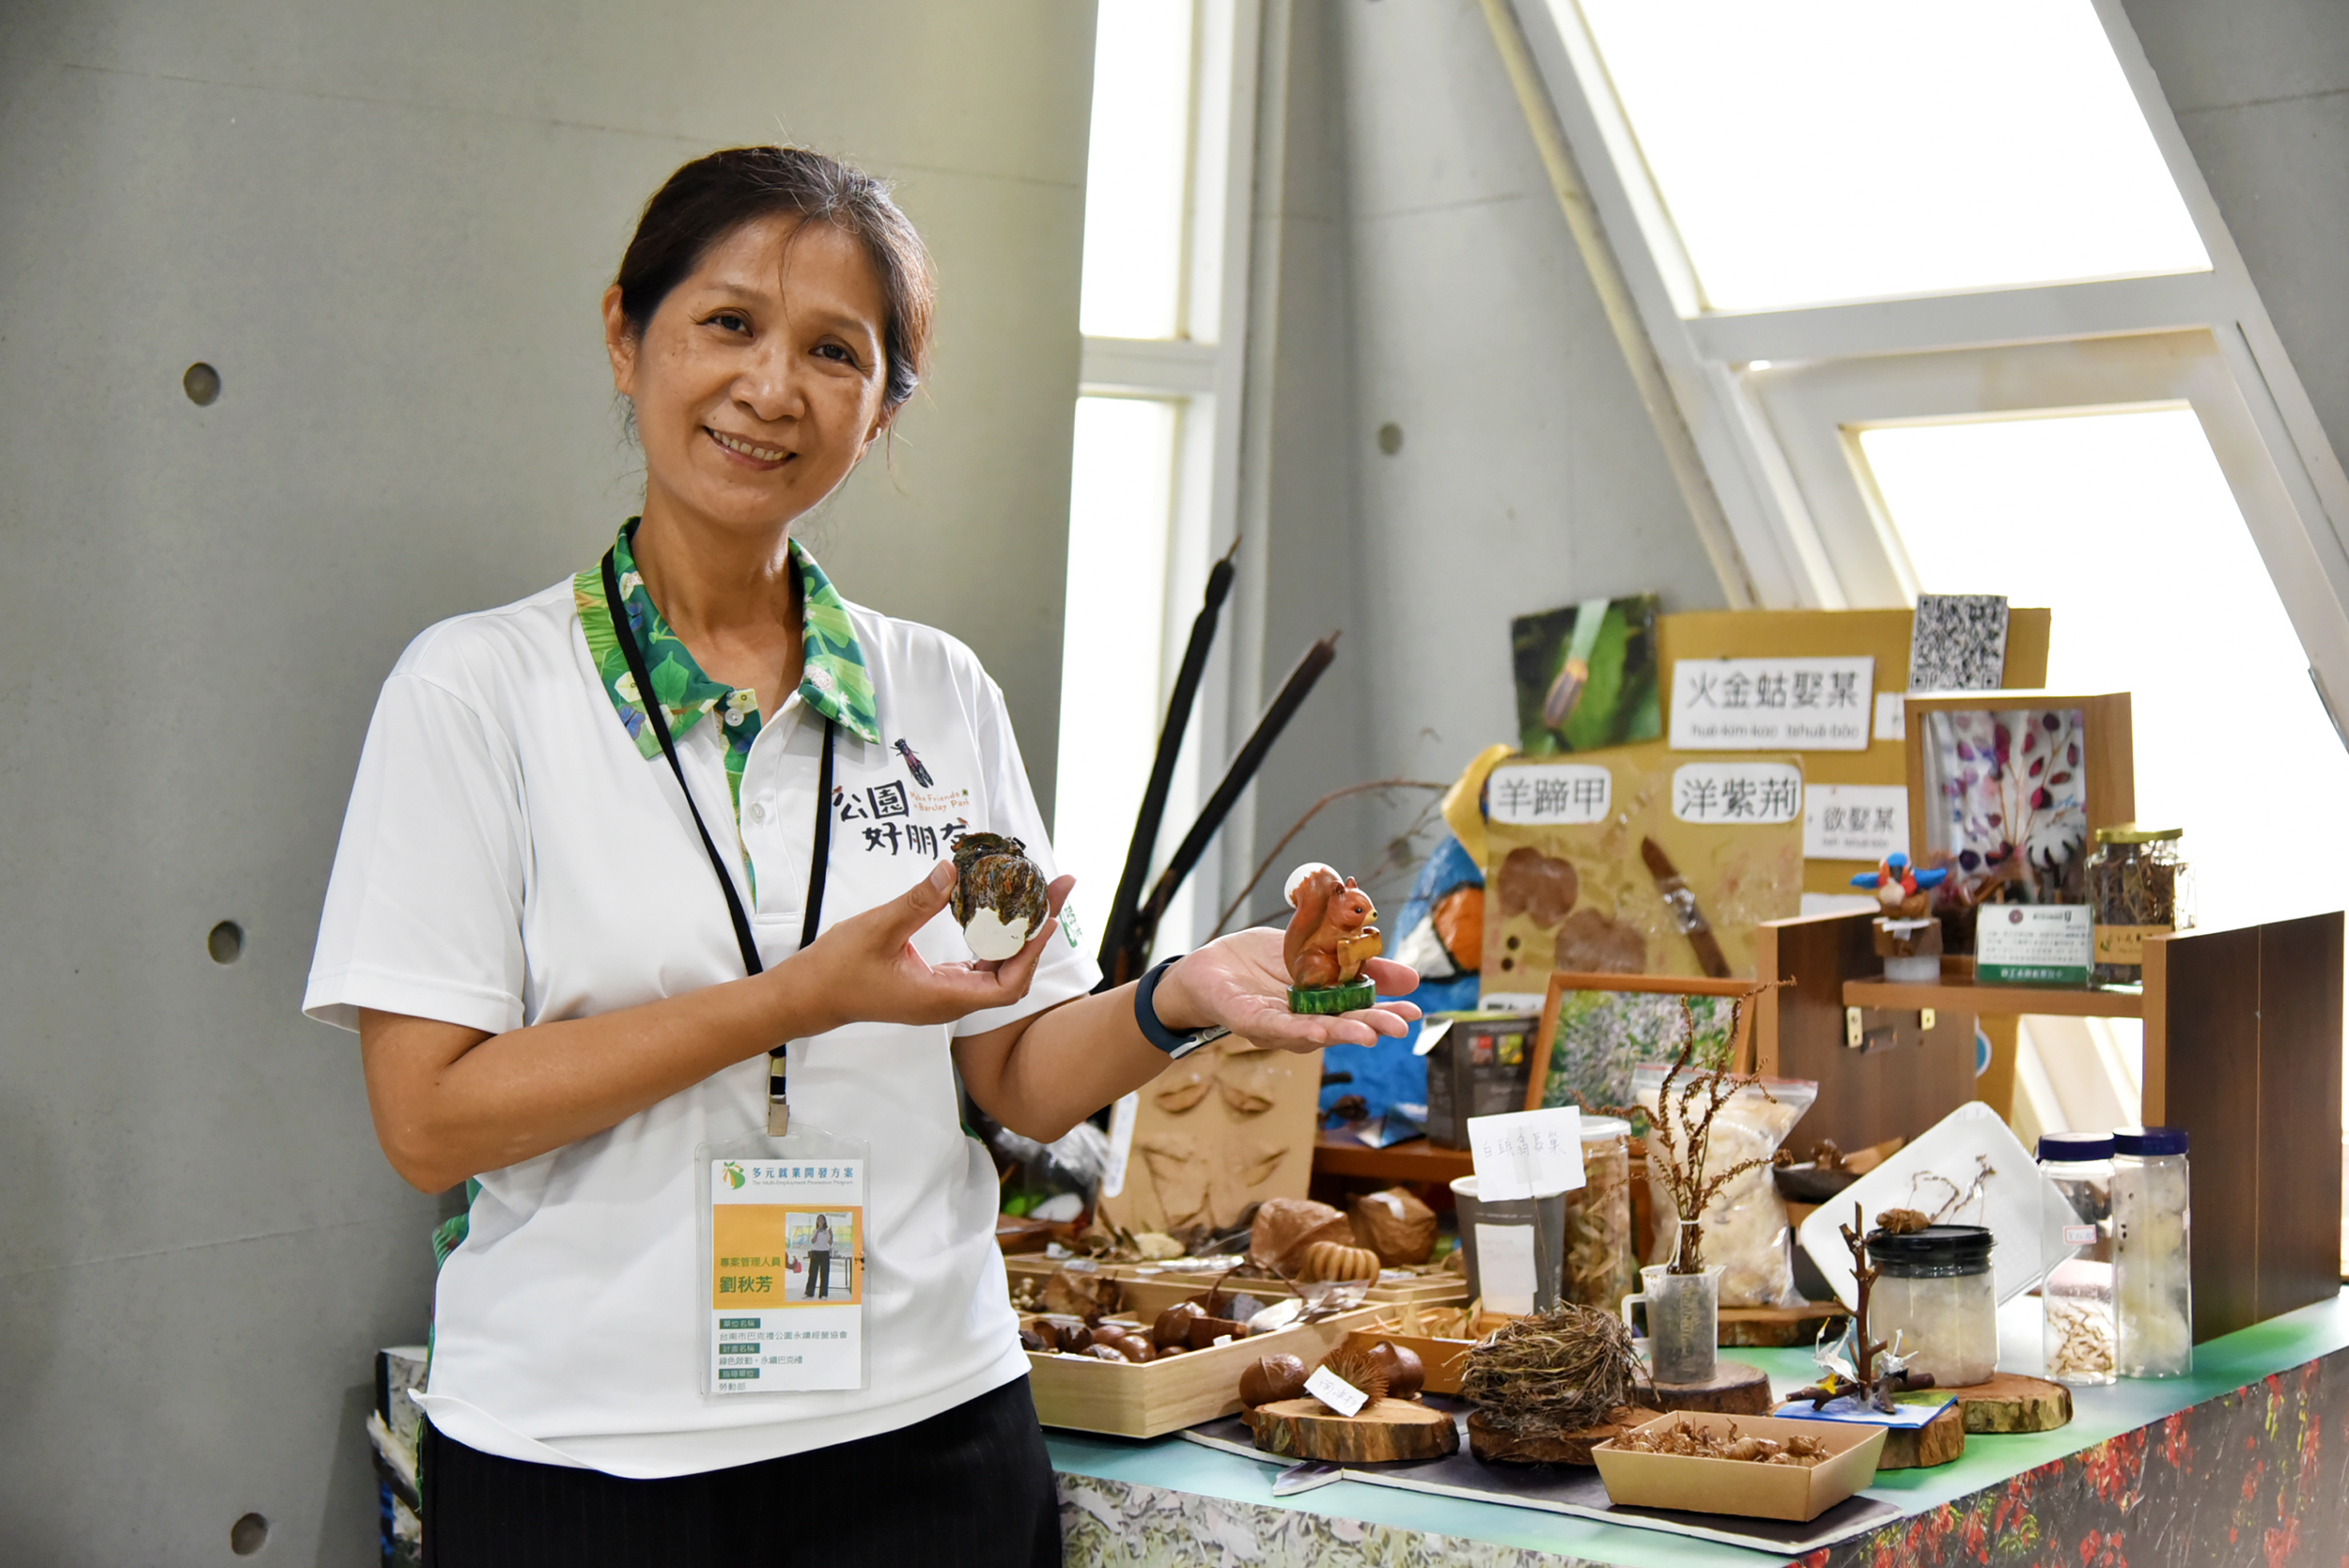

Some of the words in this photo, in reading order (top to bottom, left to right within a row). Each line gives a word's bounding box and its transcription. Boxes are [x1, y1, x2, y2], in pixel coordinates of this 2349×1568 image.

[1688, 670, 1859, 710] 火金蛄娶某
[832, 779, 910, 822] 公園
[926, 790, 960, 803] Friends
[1497, 777, 1606, 817] 羊蹄甲
[1679, 777, 1798, 818] 洋紫荊
[918, 801, 947, 813] Barclay
[950, 797, 970, 808] Park
[752, 1167, 854, 1179] 多元就業開發方案
[720, 1256, 781, 1267] 專案管理人員
[719, 1275, 773, 1294] 劉秋芳
[723, 1319, 756, 1327] 單位名稱
[718, 1382, 747, 1391] 勞動部
